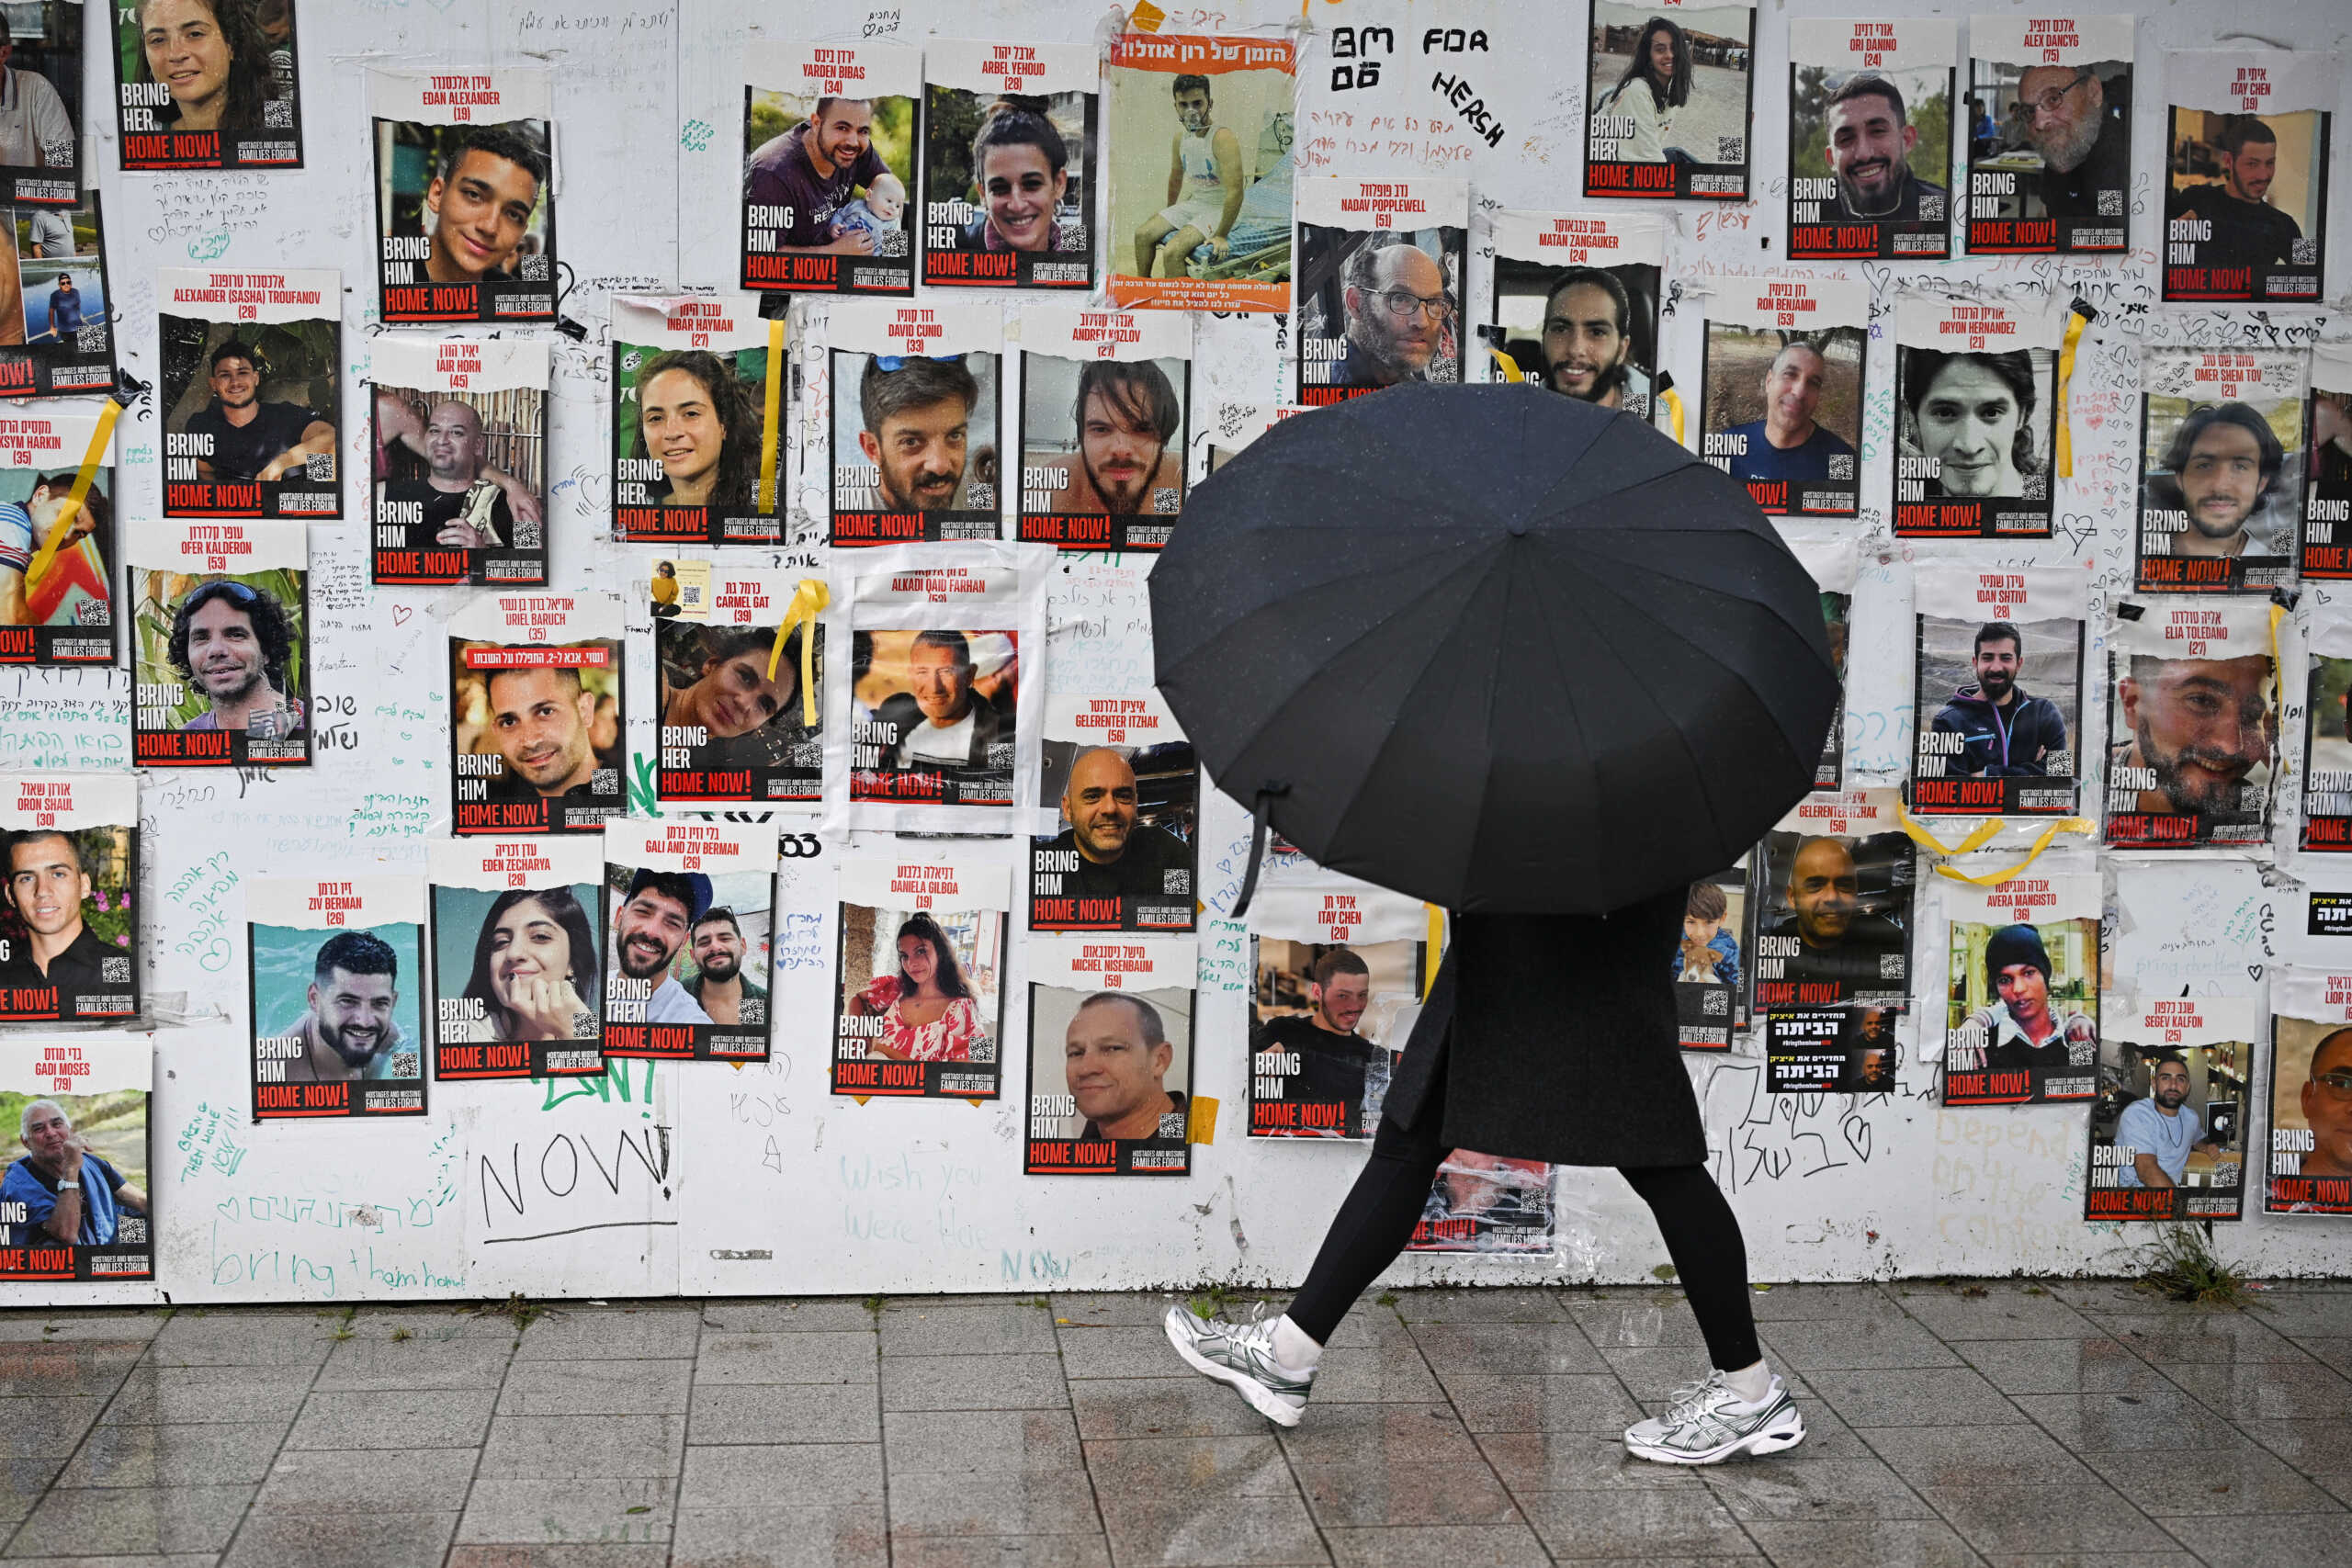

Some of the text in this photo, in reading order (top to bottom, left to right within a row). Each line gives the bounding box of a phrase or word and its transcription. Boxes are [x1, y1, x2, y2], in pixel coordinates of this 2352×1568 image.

[1423, 28, 1489, 54] FOR
[1849, 38, 1897, 52] ORI DANINO
[2024, 34, 2079, 47] ALEX DANCYG
[814, 49, 855, 65] ירדן ביבס
[991, 45, 1035, 61] ארבל יהוד
[1181, 44, 1204, 62] רון
[1210, 41, 1238, 61] של
[1245, 46, 1286, 64] הזמן
[2042, 49, 2060, 62] (75)
[1864, 52, 1883, 67] (24)
[802, 63, 866, 80] YARDEN BIBAS
[981, 60, 1046, 76] ARBEL YEHOUD
[430, 75, 492, 91] עידן אלכסנדר
[823, 79, 843, 96] (34)
[2230, 82, 2271, 96] ITAY CHEN
[422, 91, 501, 107] EDAN ALEXANDER
[453, 106, 471, 121] (19)
[1431, 72, 1505, 148] HERSH
[1972, 173, 2016, 196] BRING
[1340, 197, 1427, 213] NADAV POPPLEWELL
[1972, 196, 1999, 219] HIM
[1375, 212, 1393, 229] (51)
[1971, 219, 2056, 244] HOME NOW!
[1539, 232, 1620, 249] MATAN ZANGAUKER
[1894, 241, 1946, 251] FAMILIES FORUM
[174, 288, 321, 305] ALEXANDER (SASHA) TROUFANOV
[1757, 297, 1816, 311] RON BENJAMIN
[238, 304, 258, 320] (28)
[666, 317, 734, 333] INBAR HAYMAN
[888, 322, 944, 339] DAVID CUNIO
[1939, 321, 2017, 335] ORYON HERNANDEZ
[1969, 335, 1985, 350] (21)
[436, 358, 482, 374] IAIR HORN
[449, 374, 469, 389] (45)
[2195, 367, 2219, 382] OMER
[2221, 368, 2245, 382] SHEM
[2246, 368, 2261, 382] TOV
[27, 435, 62, 450] HARKIN
[166, 433, 215, 457] BRING
[167, 457, 198, 480] HIM
[1898, 457, 1941, 480] BRING
[168, 481, 262, 508] HOME NOW!
[278, 492, 336, 501] HOSTAGES AND MISSING
[1897, 479, 1925, 502] HIM
[279, 501, 336, 511] FAMILIES FORUM
[376, 501, 423, 525] BRING
[1897, 502, 1982, 527] HOME NOW!
[377, 525, 406, 548] HIM
[180, 540, 254, 556] OFER KALDERON
[377, 549, 469, 575] HOME NOW!
[891, 577, 924, 592] ALKADI
[948, 578, 986, 593] FARHAN
[715, 594, 771, 609] CARMEL GAT
[1976, 589, 2028, 604] IDAN SHTIVI
[505, 612, 567, 626] URIEL BARUCH
[2165, 626, 2228, 640] ELIA TOLEDANO
[1075, 714, 1159, 728] GELERENTER ITZHAK
[662, 726, 707, 747] BRING
[662, 747, 691, 769] HER
[662, 769, 752, 794] HOME NOW!
[17, 796, 74, 812] ORON SHAUL
[645, 839, 740, 856] GALI AND ZIV BERMAN
[481, 857, 551, 873] EDEN ZECHARYA
[317, 881, 353, 897] זיו ברמן
[890, 879, 958, 895] DANIELA GILBOA
[308, 896, 363, 911] ZIV BERMAN
[1986, 893, 2057, 908] AVERA MANGISTO
[326, 910, 345, 927] (26)
[1317, 910, 1362, 925] ITAY CHEN
[1071, 958, 1154, 973] MICHEL NISENBAUM
[2324, 991, 2344, 1004] LIOR
[1775, 1021, 1838, 1035] הביתה
[2145, 1014, 2204, 1028] SEGEV KALFON
[255, 1035, 302, 1060] BRING
[34, 1062, 92, 1077] GADI MOSES
[256, 1060, 286, 1083] HIM
[1255, 1052, 1301, 1076] BRING
[1776, 1065, 1839, 1078] הביתה
[53, 1077, 72, 1091] (79)
[1254, 1076, 1283, 1100] HIM
[257, 1081, 349, 1108] HOME NOW!
[1254, 1101, 1346, 1127] HOME NOW!
[178, 1101, 207, 1151] BRING
[181, 1110, 220, 1182] THEM HOME
[481, 1124, 672, 1228] NOW!
[840, 1152, 922, 1190] Wish
[213, 1219, 416, 1298] bring them
[1001, 1248, 1071, 1282] NOW
